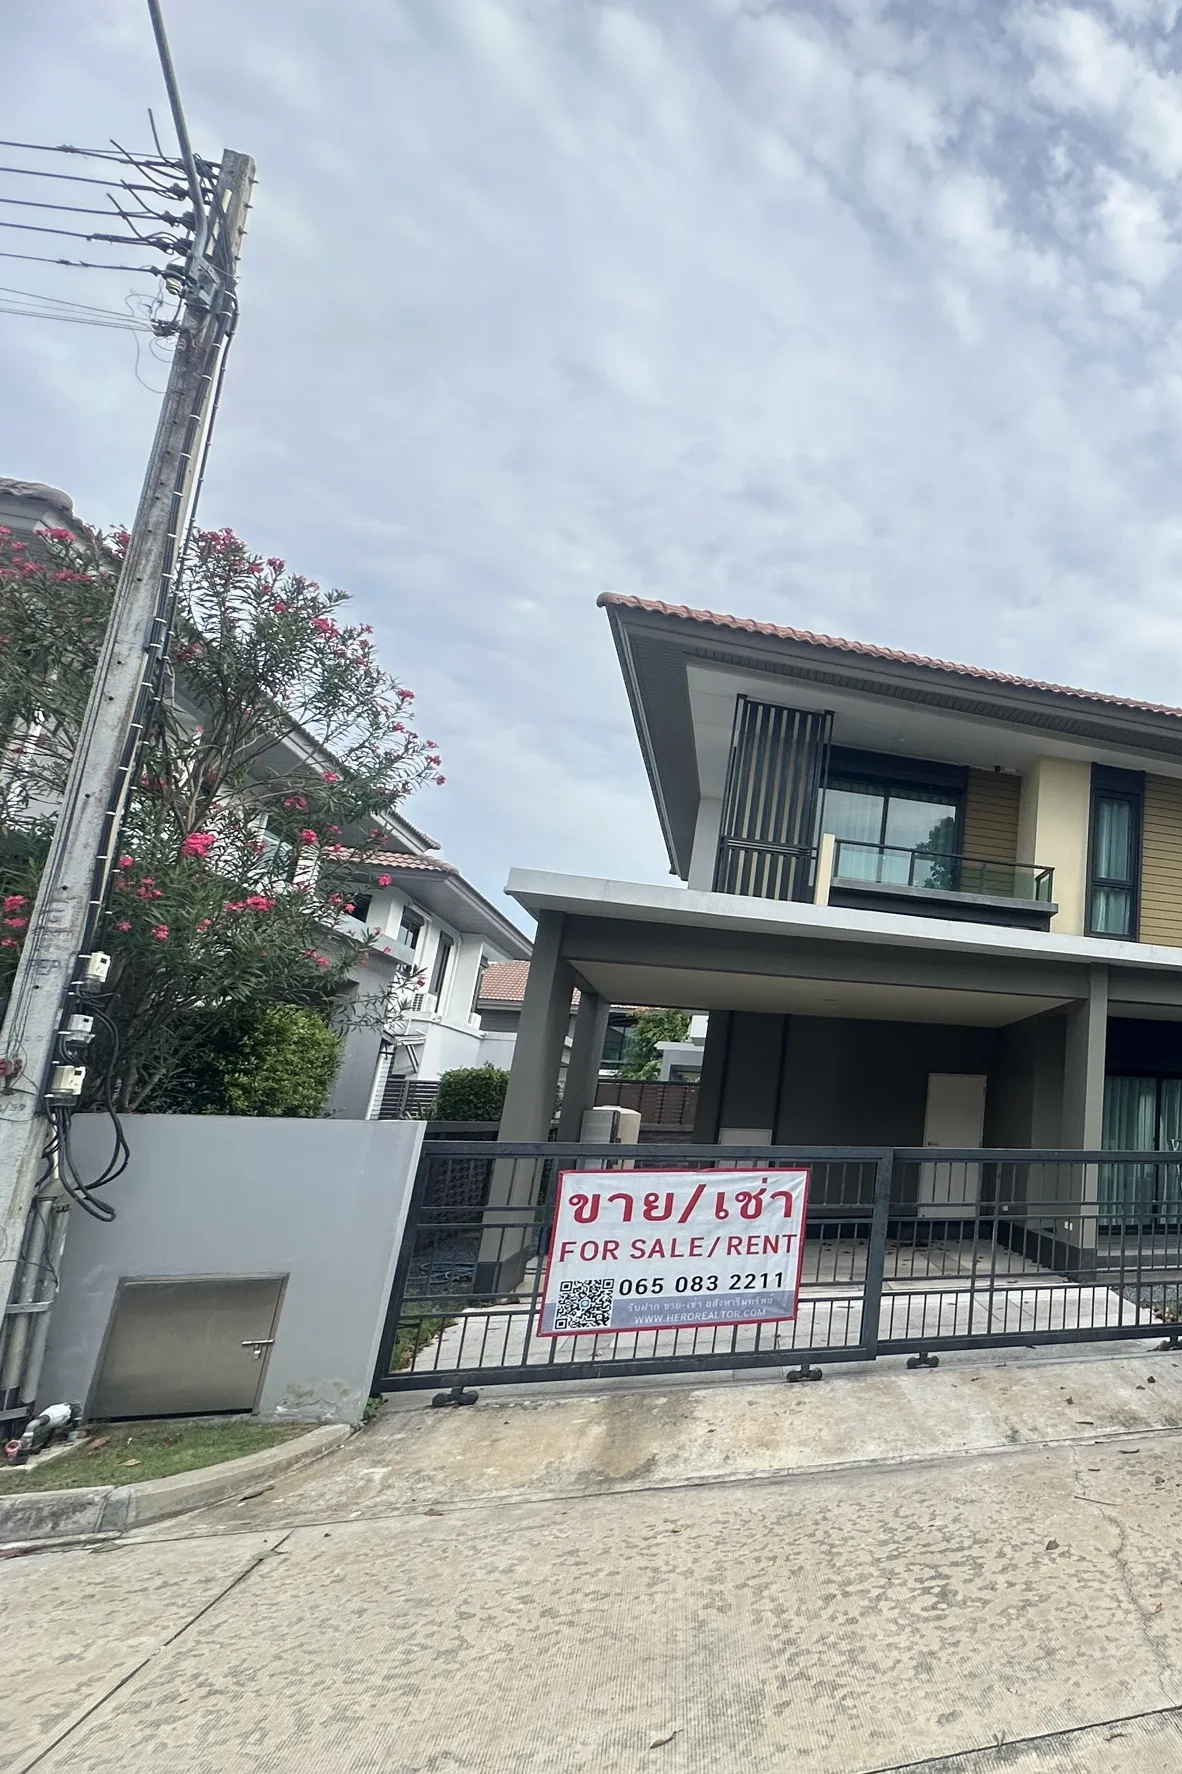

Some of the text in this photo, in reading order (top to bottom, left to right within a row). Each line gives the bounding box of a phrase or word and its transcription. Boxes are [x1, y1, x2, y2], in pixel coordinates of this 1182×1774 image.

[568, 1177, 794, 1224] ขาย/เช่า
[559, 1234, 798, 1262] FOR SALE/RENT
[618, 1272, 784, 1296] 065 083 2211
[634, 1308, 766, 1324] WWW.HEROREALTOR.COM
